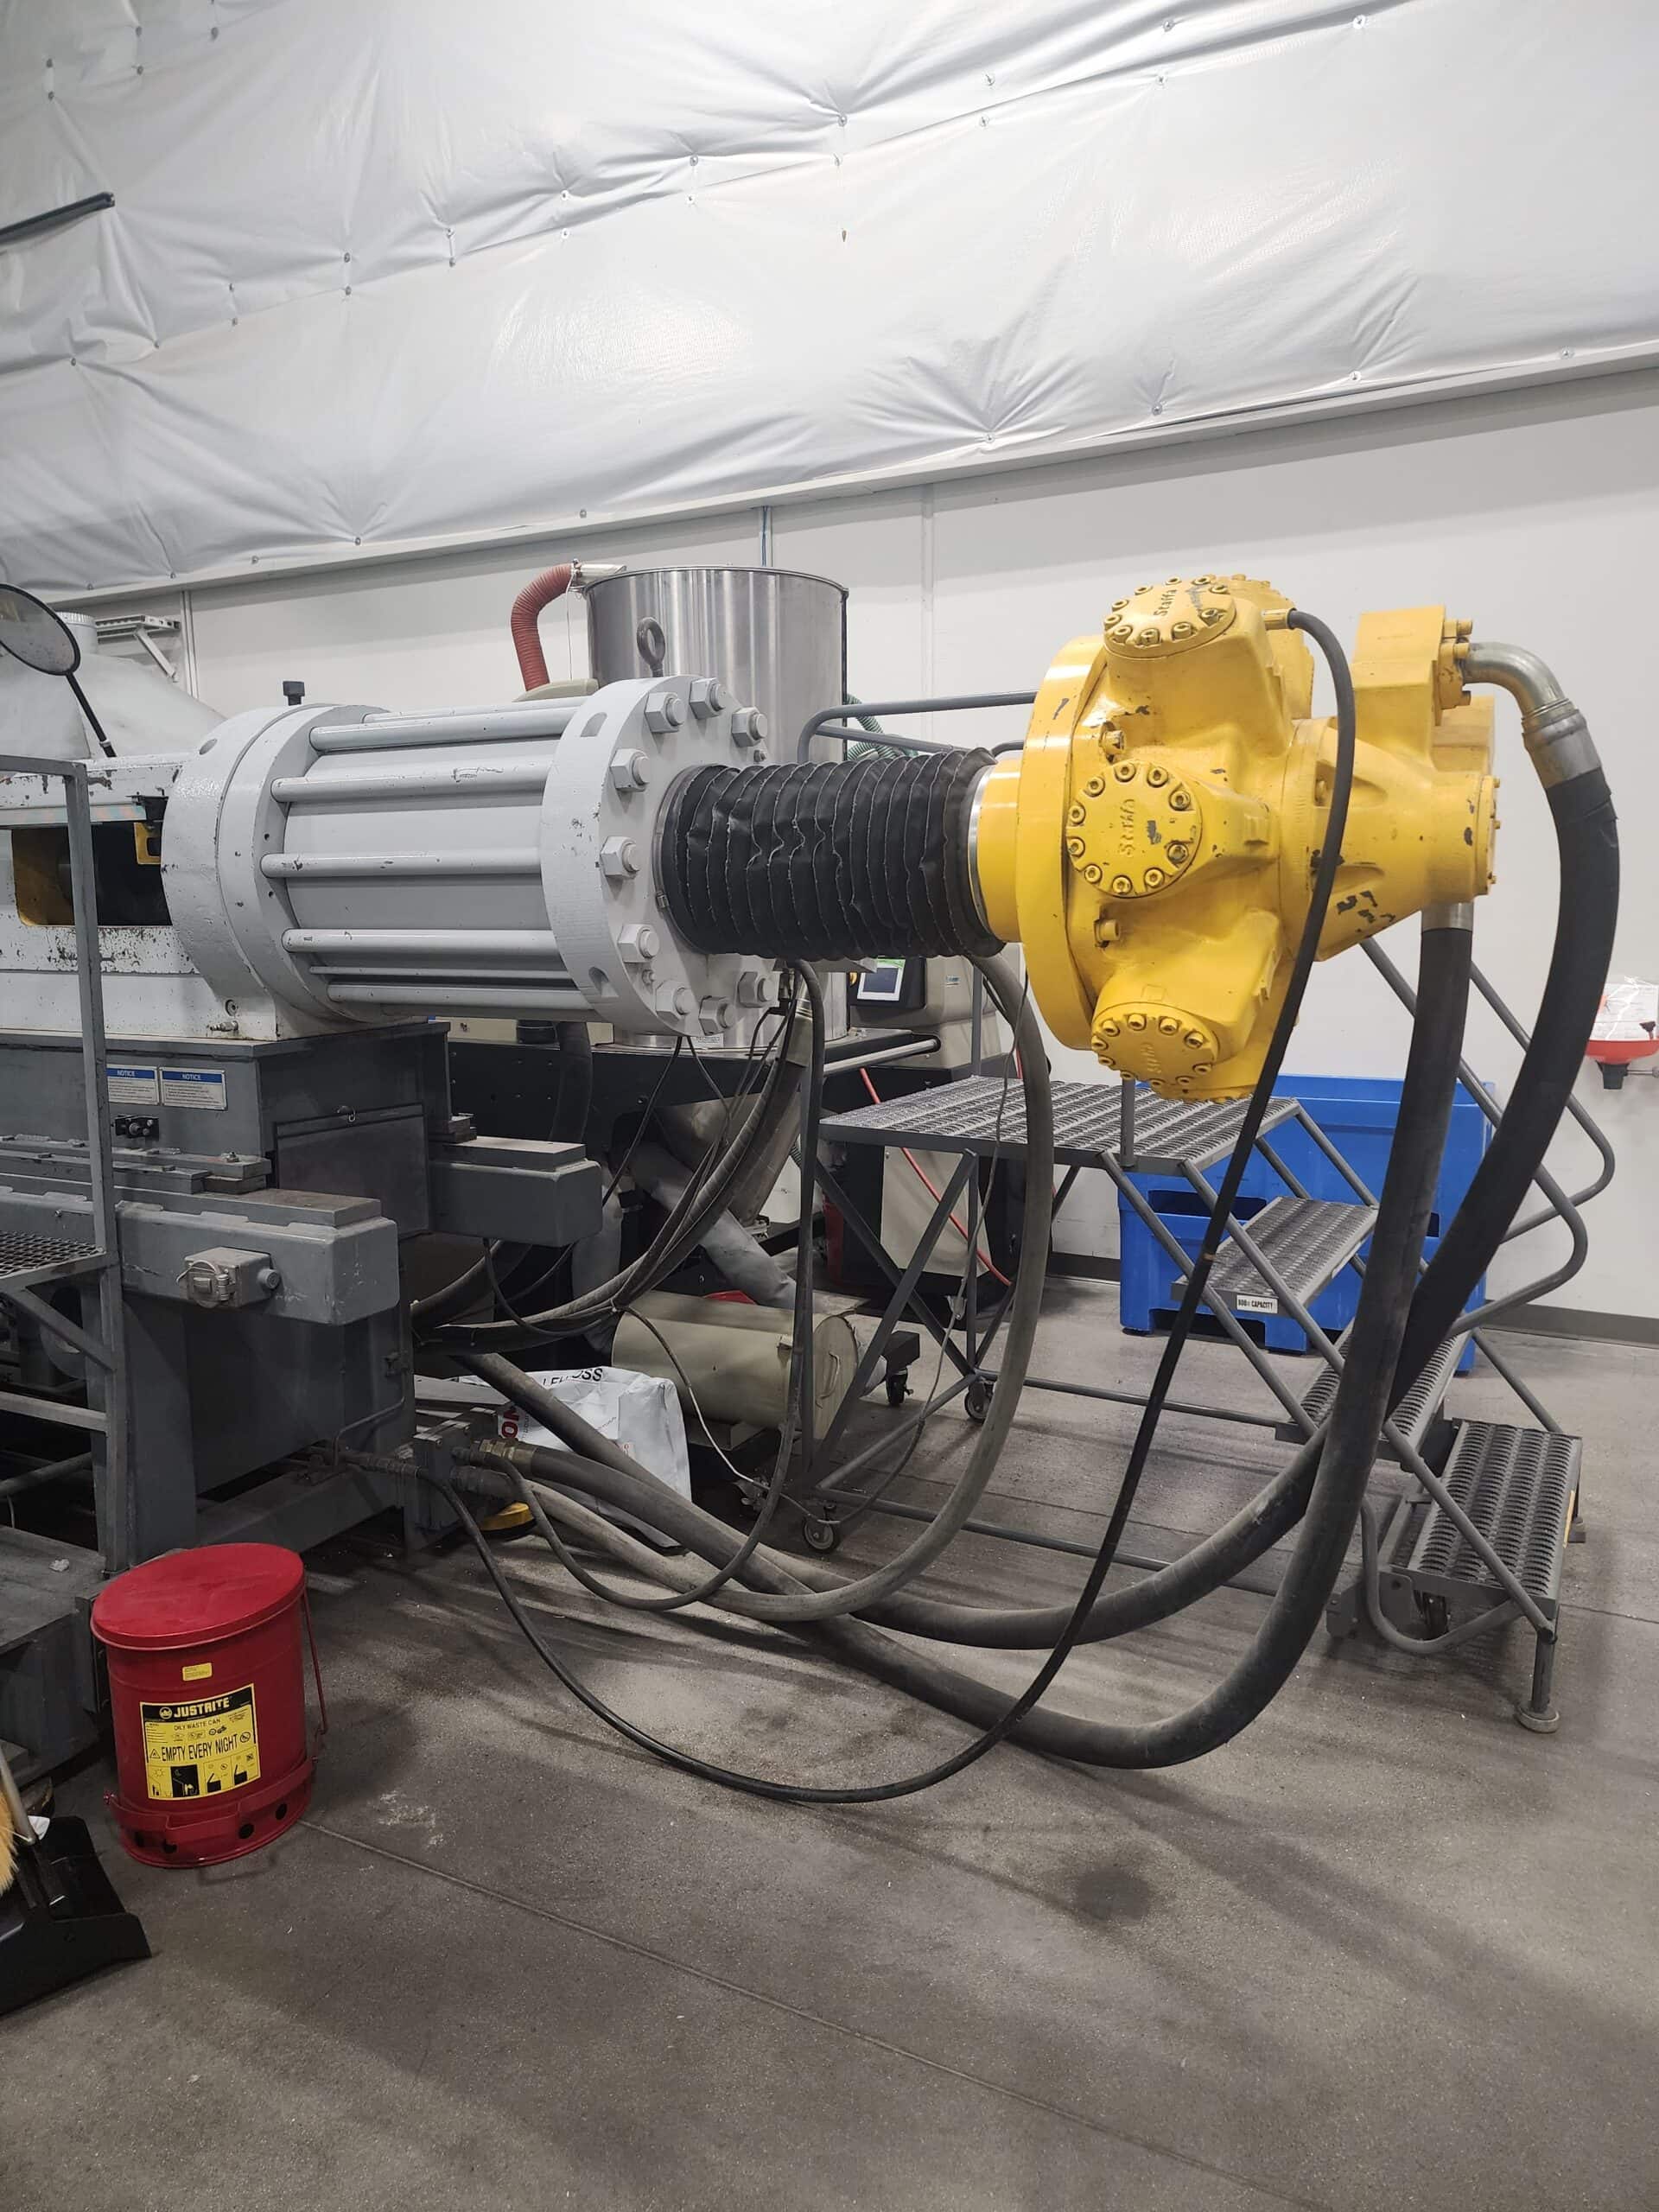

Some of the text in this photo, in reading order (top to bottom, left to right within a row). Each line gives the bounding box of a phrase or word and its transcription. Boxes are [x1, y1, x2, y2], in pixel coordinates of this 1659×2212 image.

[174, 1697, 231, 1718] JUSTRITE
[186, 1721, 207, 1730] WASTE
[208, 1718, 221, 1726] CAN
[161, 1734, 238, 1762] EMPTY EVERY NIGHT
